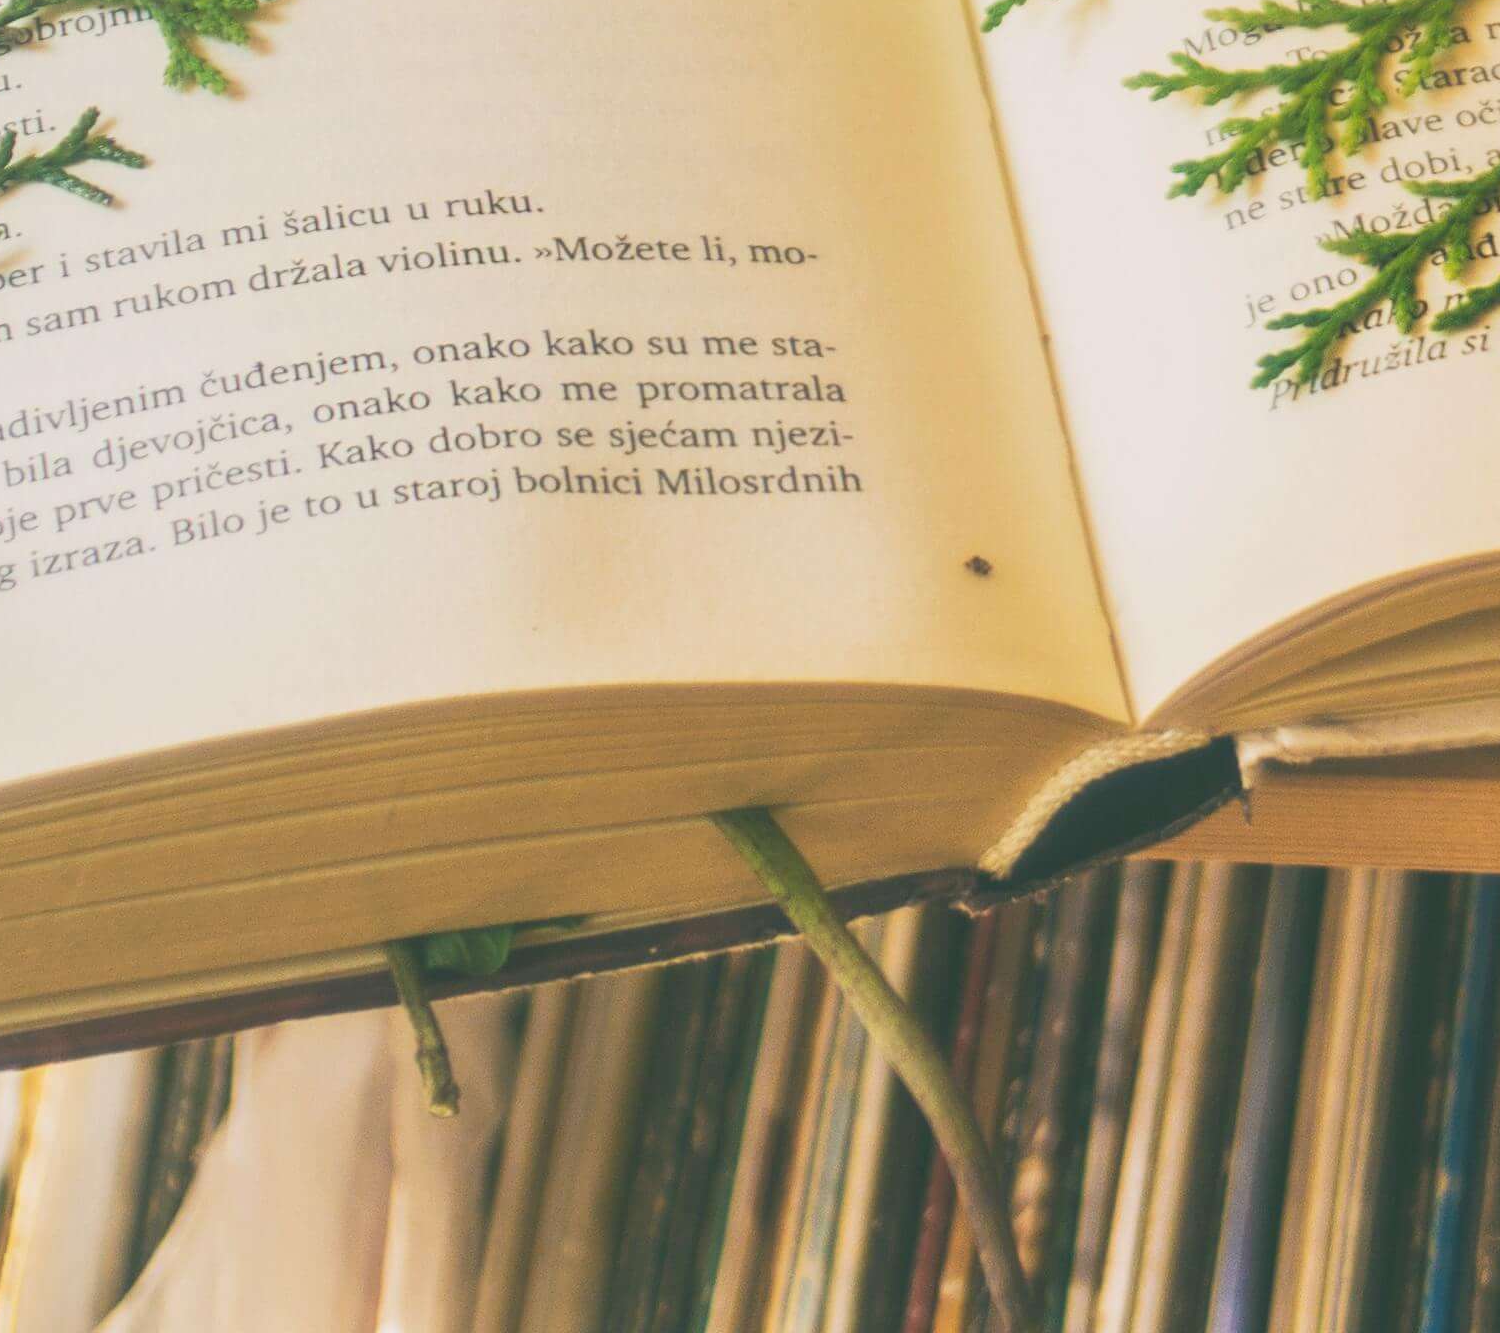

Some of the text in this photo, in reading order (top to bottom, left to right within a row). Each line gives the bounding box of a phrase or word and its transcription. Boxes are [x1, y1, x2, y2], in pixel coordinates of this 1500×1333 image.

[26, 234, 820, 337] sam rukom držala violinu. »Možete li, mo-
[60, 189, 544, 278] i stavila mi šalicu u ruku.
[199, 351, 398, 398] čuđenjem,
[412, 332, 531, 364] onako
[544, 328, 634, 357] kako
[647, 336, 688, 356] su
[702, 336, 758, 356] me
[771, 336, 836, 358] sta-
[3, 374, 847, 488] bila djevojčica, onako kako me promatrala
[54, 490, 136, 533] prve
[151, 450, 302, 511] pričesti.
[319, 434, 414, 470] Kako
[428, 423, 543, 454] dobro
[556, 427, 593, 448] se
[609, 420, 738, 456] sjećam
[752, 420, 853, 454] njezi-
[31, 464, 864, 578] izraza. Bilo je to u staroj bolnici Milosrdnih
